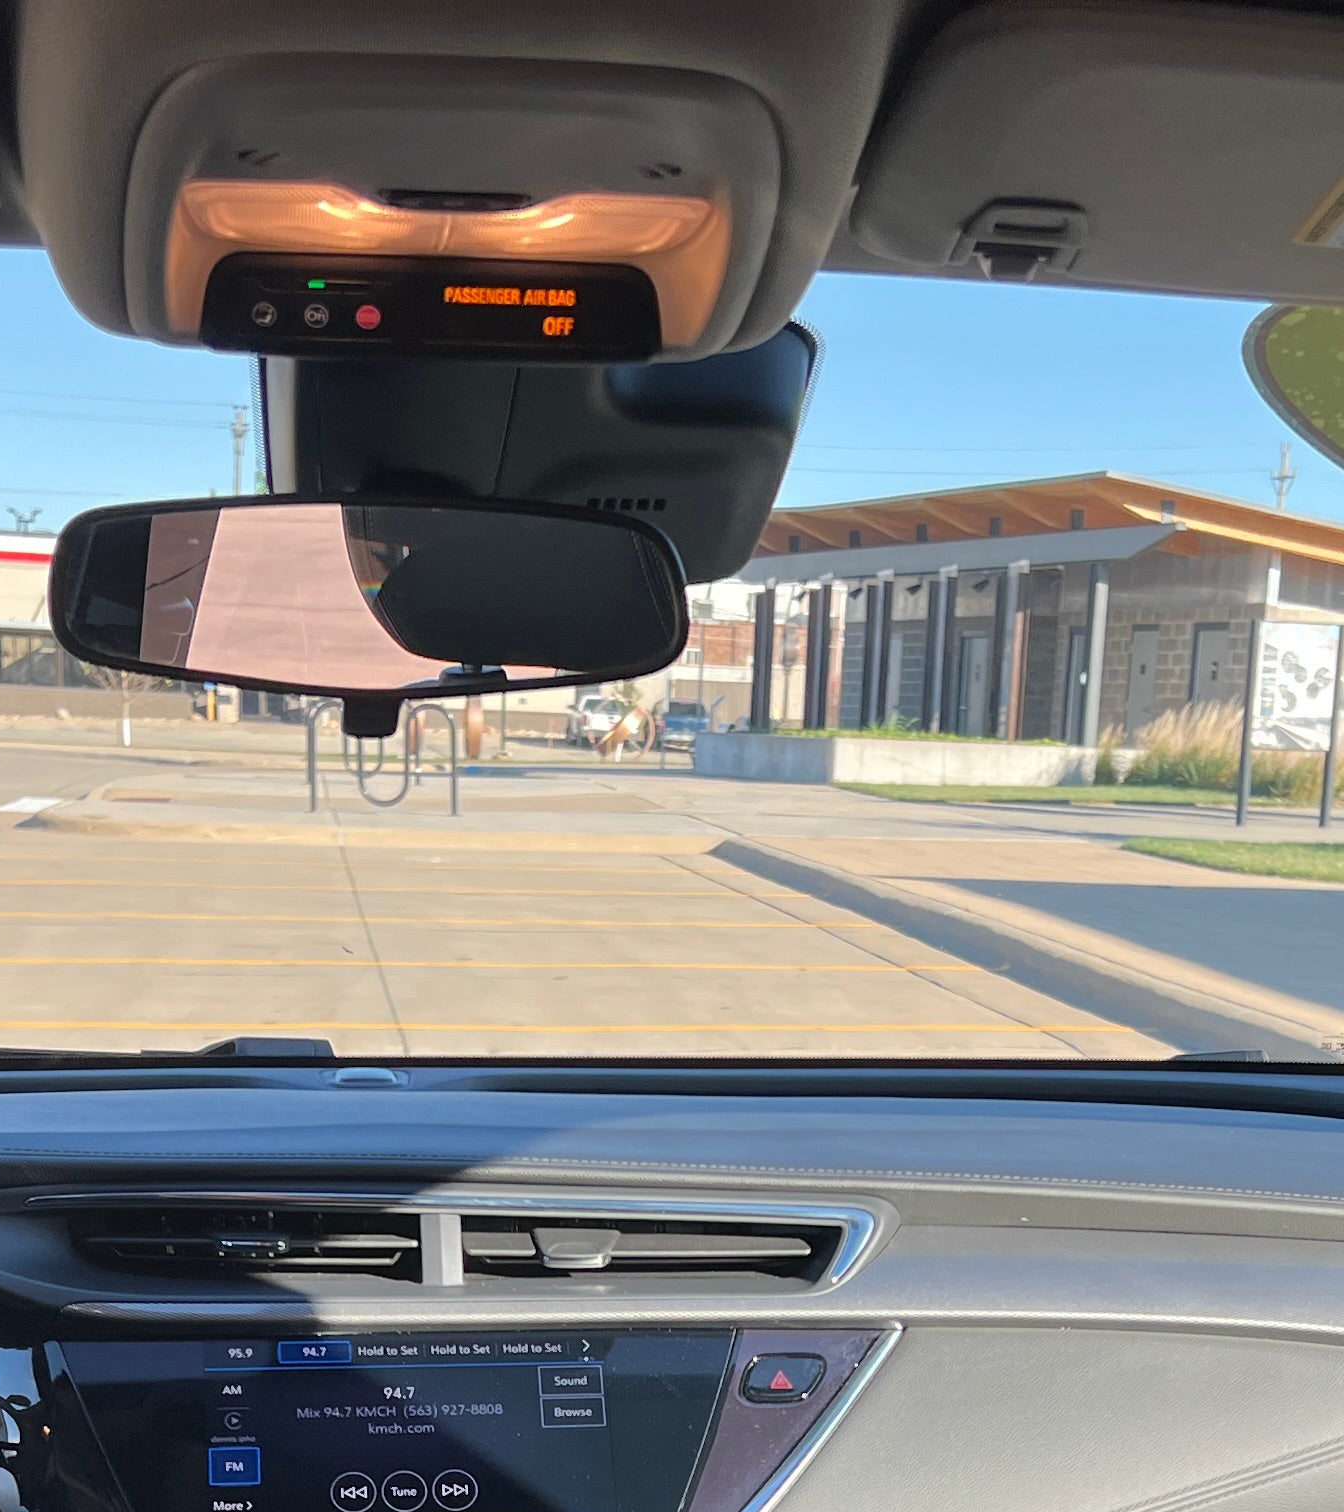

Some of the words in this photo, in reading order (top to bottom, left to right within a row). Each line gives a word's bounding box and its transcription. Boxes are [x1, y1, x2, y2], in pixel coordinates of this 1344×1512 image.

[443, 286, 521, 305] PASSENGER
[523, 288, 546, 305] AIR
[547, 289, 577, 306] BAG
[541, 316, 576, 336] OFF
[227, 1347, 254, 1359] 95.9
[302, 1346, 327, 1358] 94.7
[357, 1345, 384, 1356] Hold
[386, 1346, 398, 1355] to
[400, 1345, 418, 1355] Set
[430, 1344, 457, 1355] Hold
[458, 1345, 470, 1355] to
[472, 1344, 491, 1355] Set
[502, 1343, 530, 1354] Hold
[530, 1344, 543, 1353] to
[544, 1342, 563, 1353] Set
[553, 1375, 588, 1386] Sound
[221, 1385, 242, 1395] AM
[383, 1386, 415, 1400] 94.7
[296, 1408, 321, 1419] Mix
[323, 1406, 352, 1418] 94.7
[356, 1406, 397, 1418] KMCH
[403, 1404, 438, 1419] (563)
[441, 1403, 504, 1417] 927-8808
[554, 1407, 593, 1418] Browse
[367, 1422, 435, 1435] kmch.com
[225, 1461, 244, 1472] FM
[390, 1486, 418, 1497] Tune
[213, 1500, 244, 1511] More
